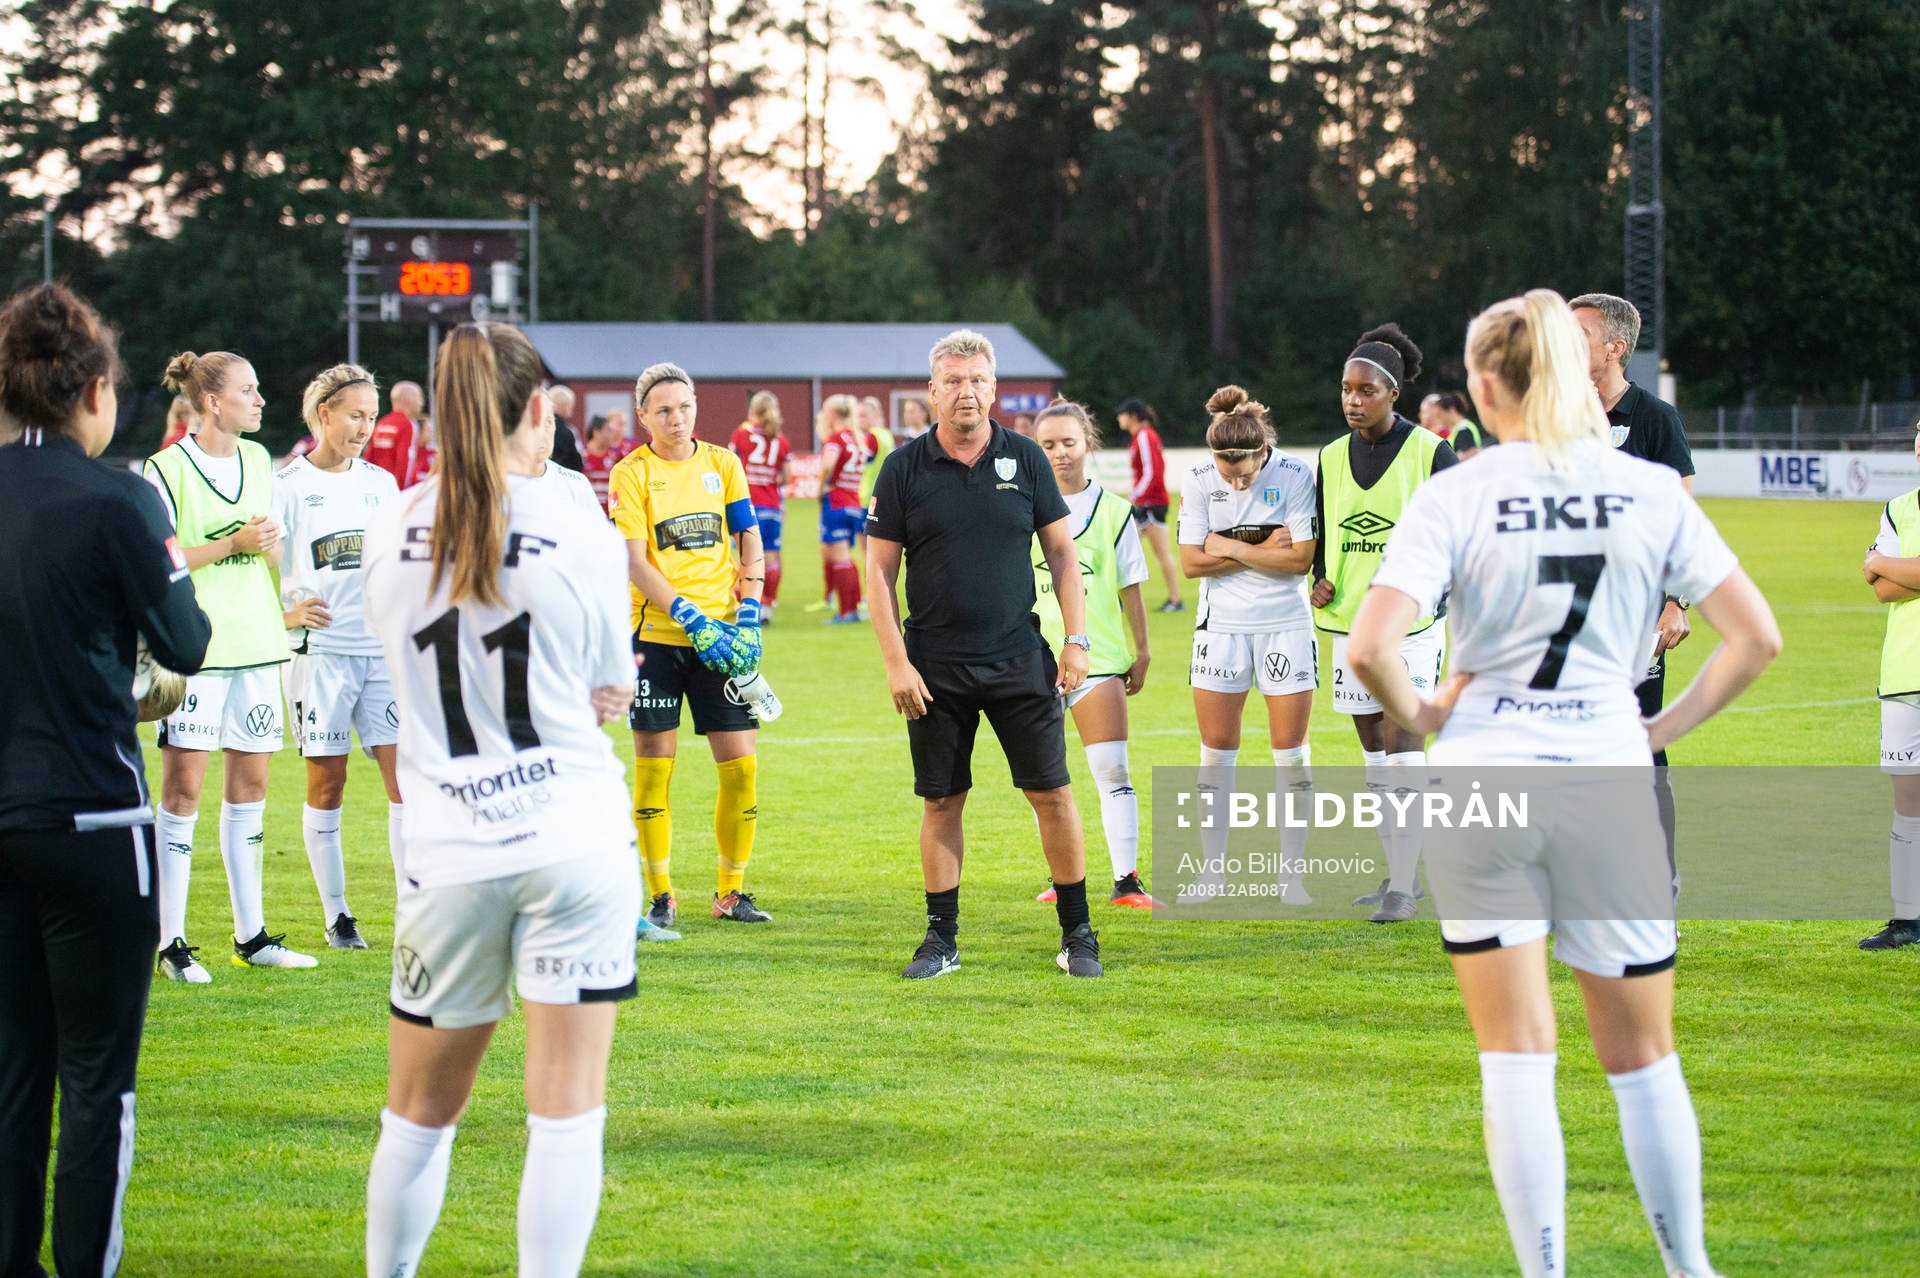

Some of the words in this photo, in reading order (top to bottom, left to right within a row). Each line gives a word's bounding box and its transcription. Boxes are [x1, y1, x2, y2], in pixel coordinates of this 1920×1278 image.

[400, 261, 471, 295] 2053
[748, 433, 780, 465] 21
[1761, 456, 1821, 486] MBE
[1496, 493, 1634, 533] SKF
[317, 535, 363, 563] KOPPAR
[400, 526, 557, 568] SF
[1528, 554, 1606, 690] 7
[1197, 644, 1208, 660] 14
[412, 606, 542, 759] 11
[1194, 665, 1238, 679] BRIXLY
[635, 679, 650, 697] 13
[1335, 691, 1372, 702] RIXLY
[307, 707, 317, 725] 4
[634, 698, 678, 708] BRIXLY
[535, 957, 620, 978] BRIXLY
